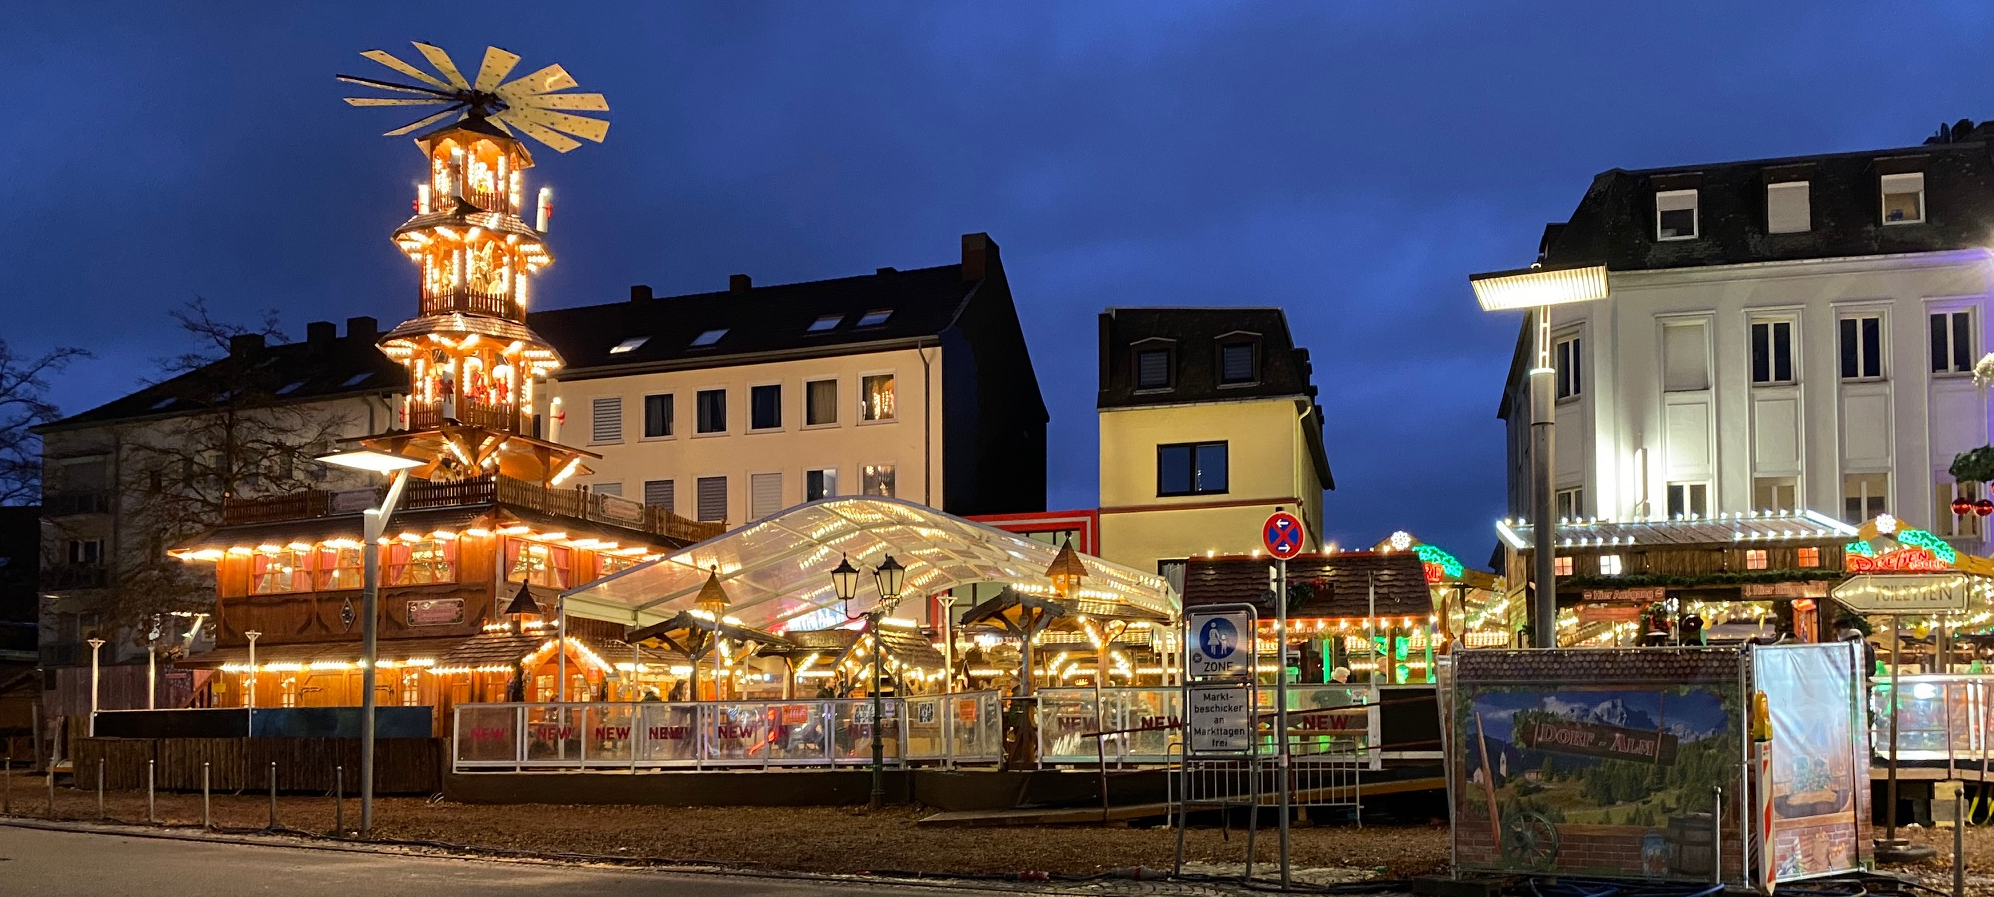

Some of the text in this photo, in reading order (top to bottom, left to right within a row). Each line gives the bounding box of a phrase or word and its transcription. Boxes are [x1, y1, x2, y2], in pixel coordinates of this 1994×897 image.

[1875, 585, 1953, 601] TOILETTEN
[1204, 662, 1234, 672] ZONE
[1203, 693, 1234, 701] Markt-
[1194, 704, 1243, 713] beschicker
[1057, 717, 1098, 731] NEW
[1213, 716, 1224, 724] an
[1303, 715, 1347, 730] NEW
[470, 727, 505, 740] NEW
[537, 727, 572, 740] NEW
[595, 727, 631, 740] NEW
[718, 726, 753, 739] NEW
[1194, 727, 1245, 737] Markttagen
[1211, 738, 1228, 747] frei
[1540, 724, 1594, 747] DORF
[1610, 733, 1655, 756] ALM
